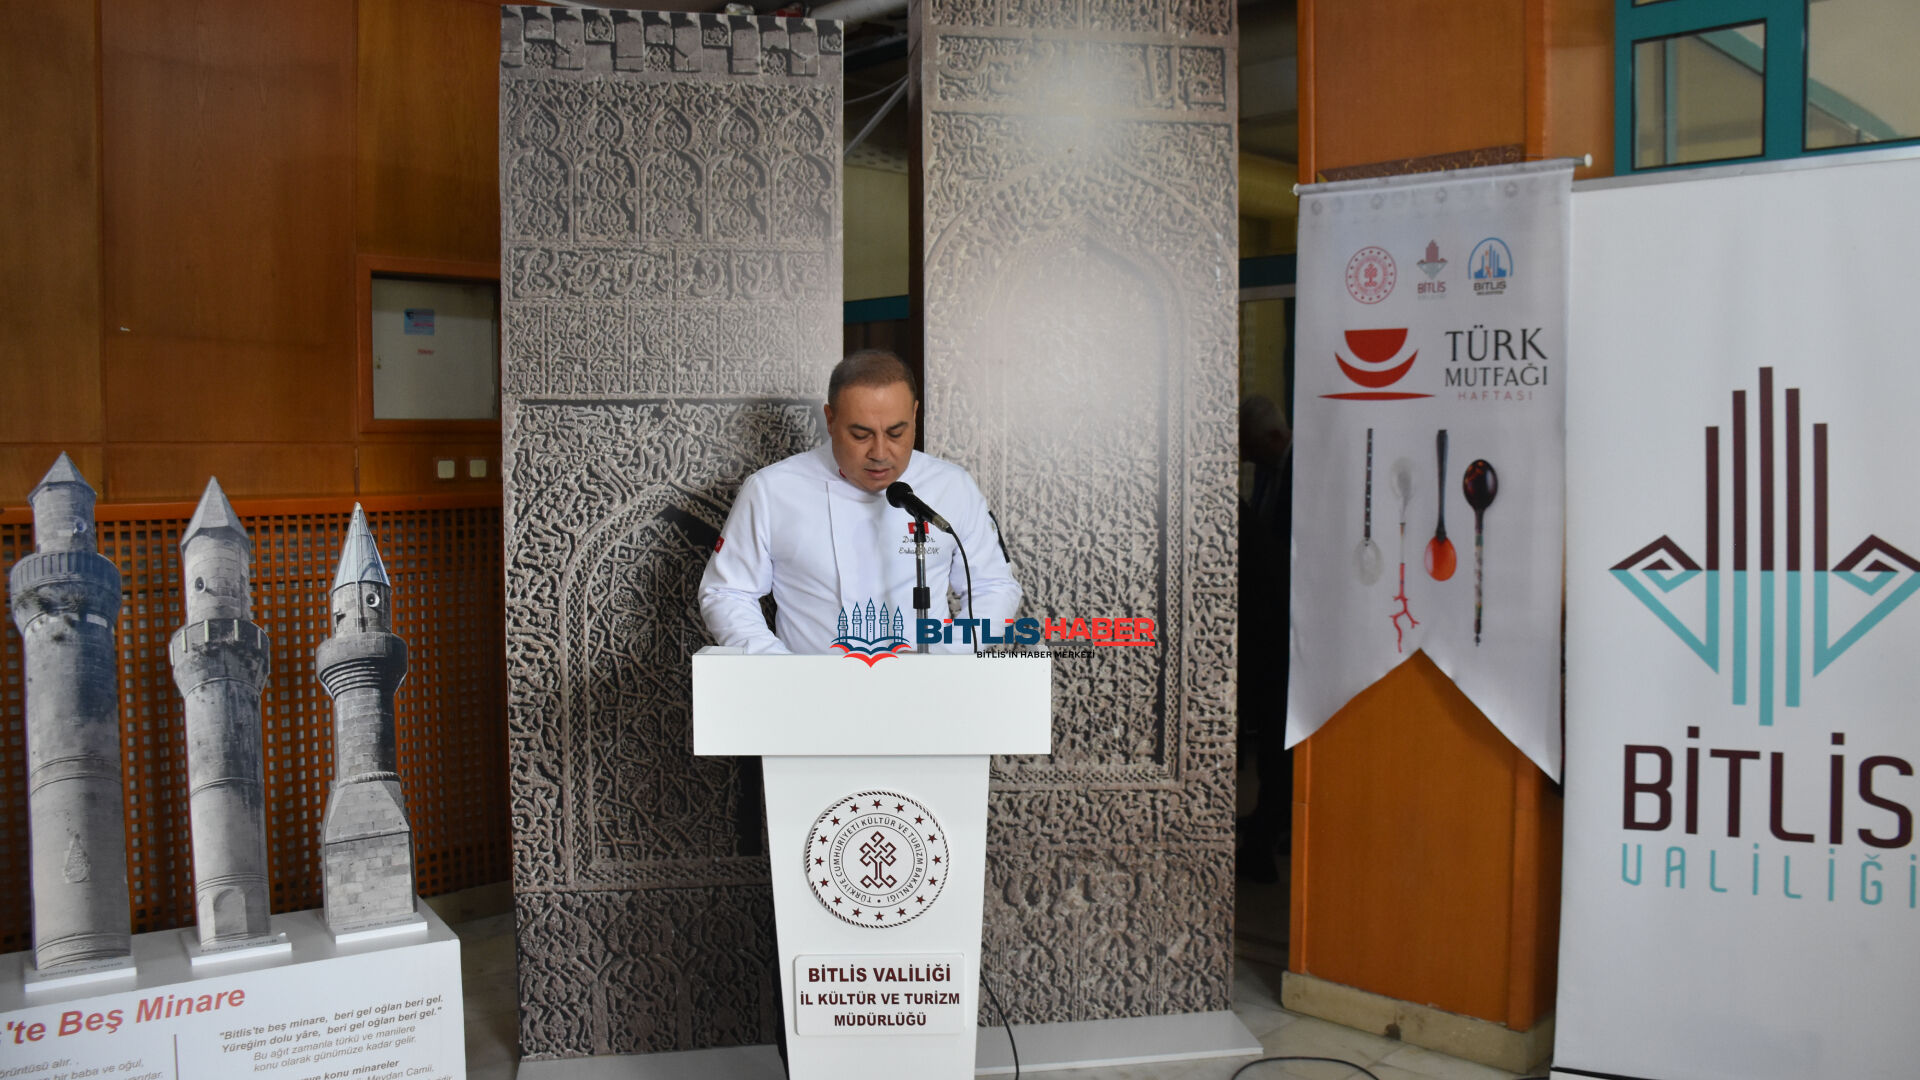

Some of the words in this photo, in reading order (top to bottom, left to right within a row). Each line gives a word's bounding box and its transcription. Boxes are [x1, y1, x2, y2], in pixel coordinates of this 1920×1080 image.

[1444, 325, 1548, 362] TÜRK
[1445, 363, 1548, 388] MUTFAĞI
[1458, 390, 1533, 401] HAFTASI
[1623, 726, 1914, 849] BİTLİS
[861, 816, 896, 827] KÜLTÜR
[898, 823, 909, 833] VE
[907, 832, 924, 865] TURİZM
[808, 964, 867, 982] BİTLİS
[873, 963, 951, 982] VALİLİĞİ
[800, 991, 813, 1005] İL
[818, 992, 876, 1005] KÜLTÜR
[880, 993, 899, 1005] VE
[906, 992, 960, 1005] TURİZM
[0, 1021, 46, 1045] 'te
[58, 1008, 124, 1037] Beş
[136, 988, 245, 1023] Minare
[267, 1023, 287, 1034] beş
[334, 1009, 354, 1020] beri
[356, 1007, 372, 1019] gel
[405, 997, 424, 1008] beri
[834, 1012, 927, 1026] MÜDÜRLÜĞÜ
[222, 1039, 267, 1053] Yüreğim
[269, 1034, 293, 1045] dolu
[327, 1023, 347, 1034] beri
[349, 1020, 365, 1032] gel
[398, 1011, 417, 1022] beri
[362, 1033, 374, 1041] ve
